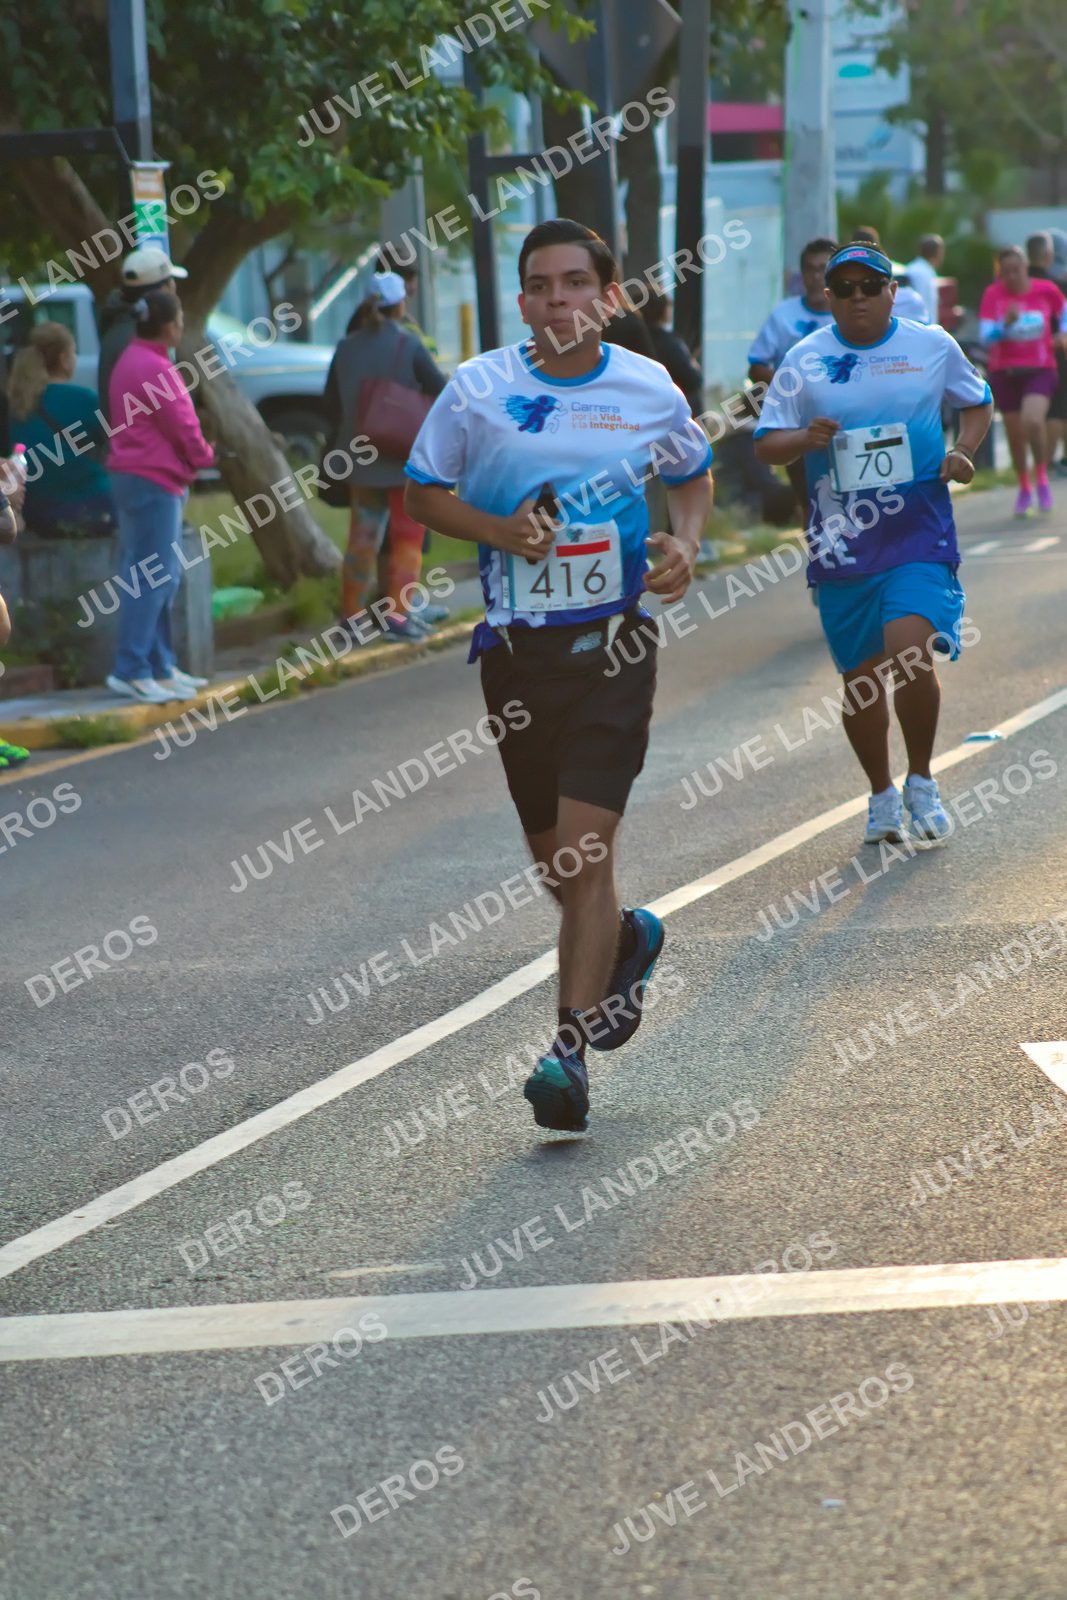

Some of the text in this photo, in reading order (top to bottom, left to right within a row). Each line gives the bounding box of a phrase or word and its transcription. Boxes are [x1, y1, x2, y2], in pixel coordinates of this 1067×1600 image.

[869, 355, 908, 363] Carrera
[571, 401, 620, 414] Carrera
[600, 413, 622, 422] Vida
[590, 421, 641, 432] Integridad
[855, 450, 893, 480] 70
[529, 559, 607, 599] 416
